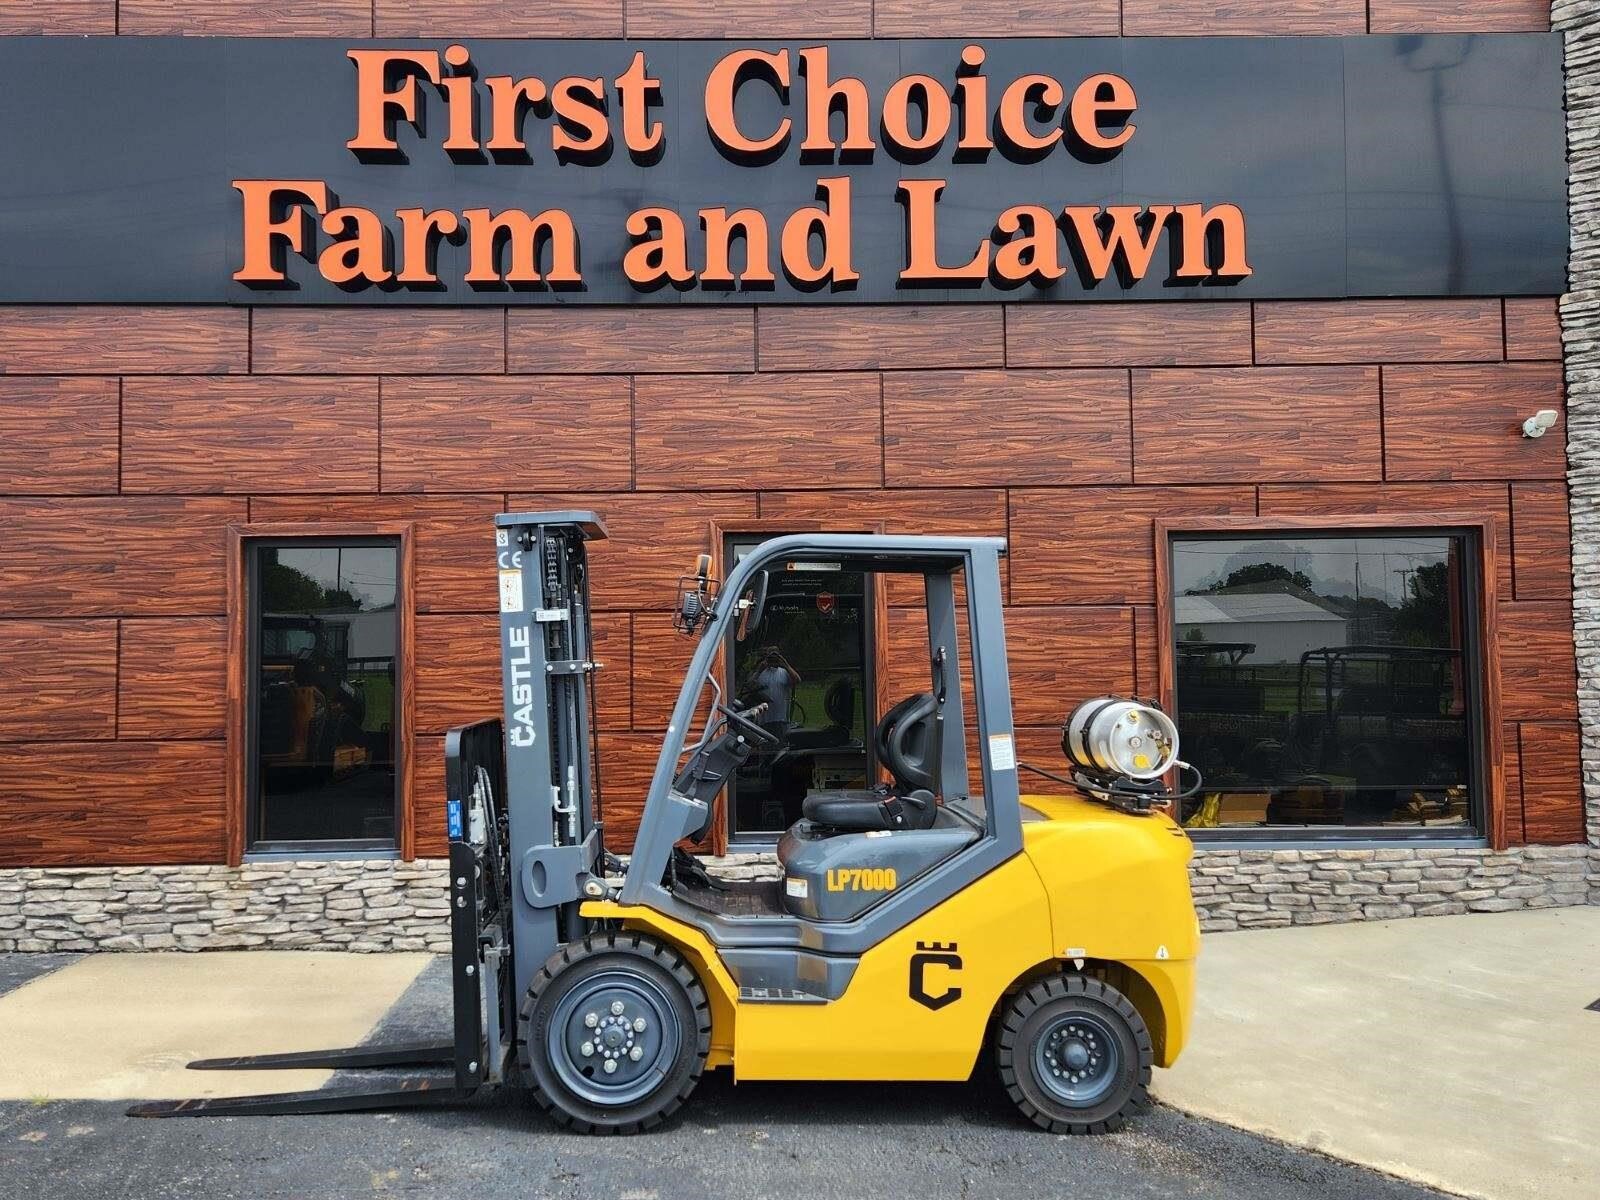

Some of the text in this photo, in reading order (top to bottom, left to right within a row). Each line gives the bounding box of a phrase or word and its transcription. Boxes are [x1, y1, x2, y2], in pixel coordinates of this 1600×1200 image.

[347, 44, 1138, 152] First Choice
[232, 176, 1254, 283] Farm and Lawn
[498, 550, 522, 569] CE
[509, 626, 537, 748] CASTLE
[827, 867, 897, 893] LP7000
